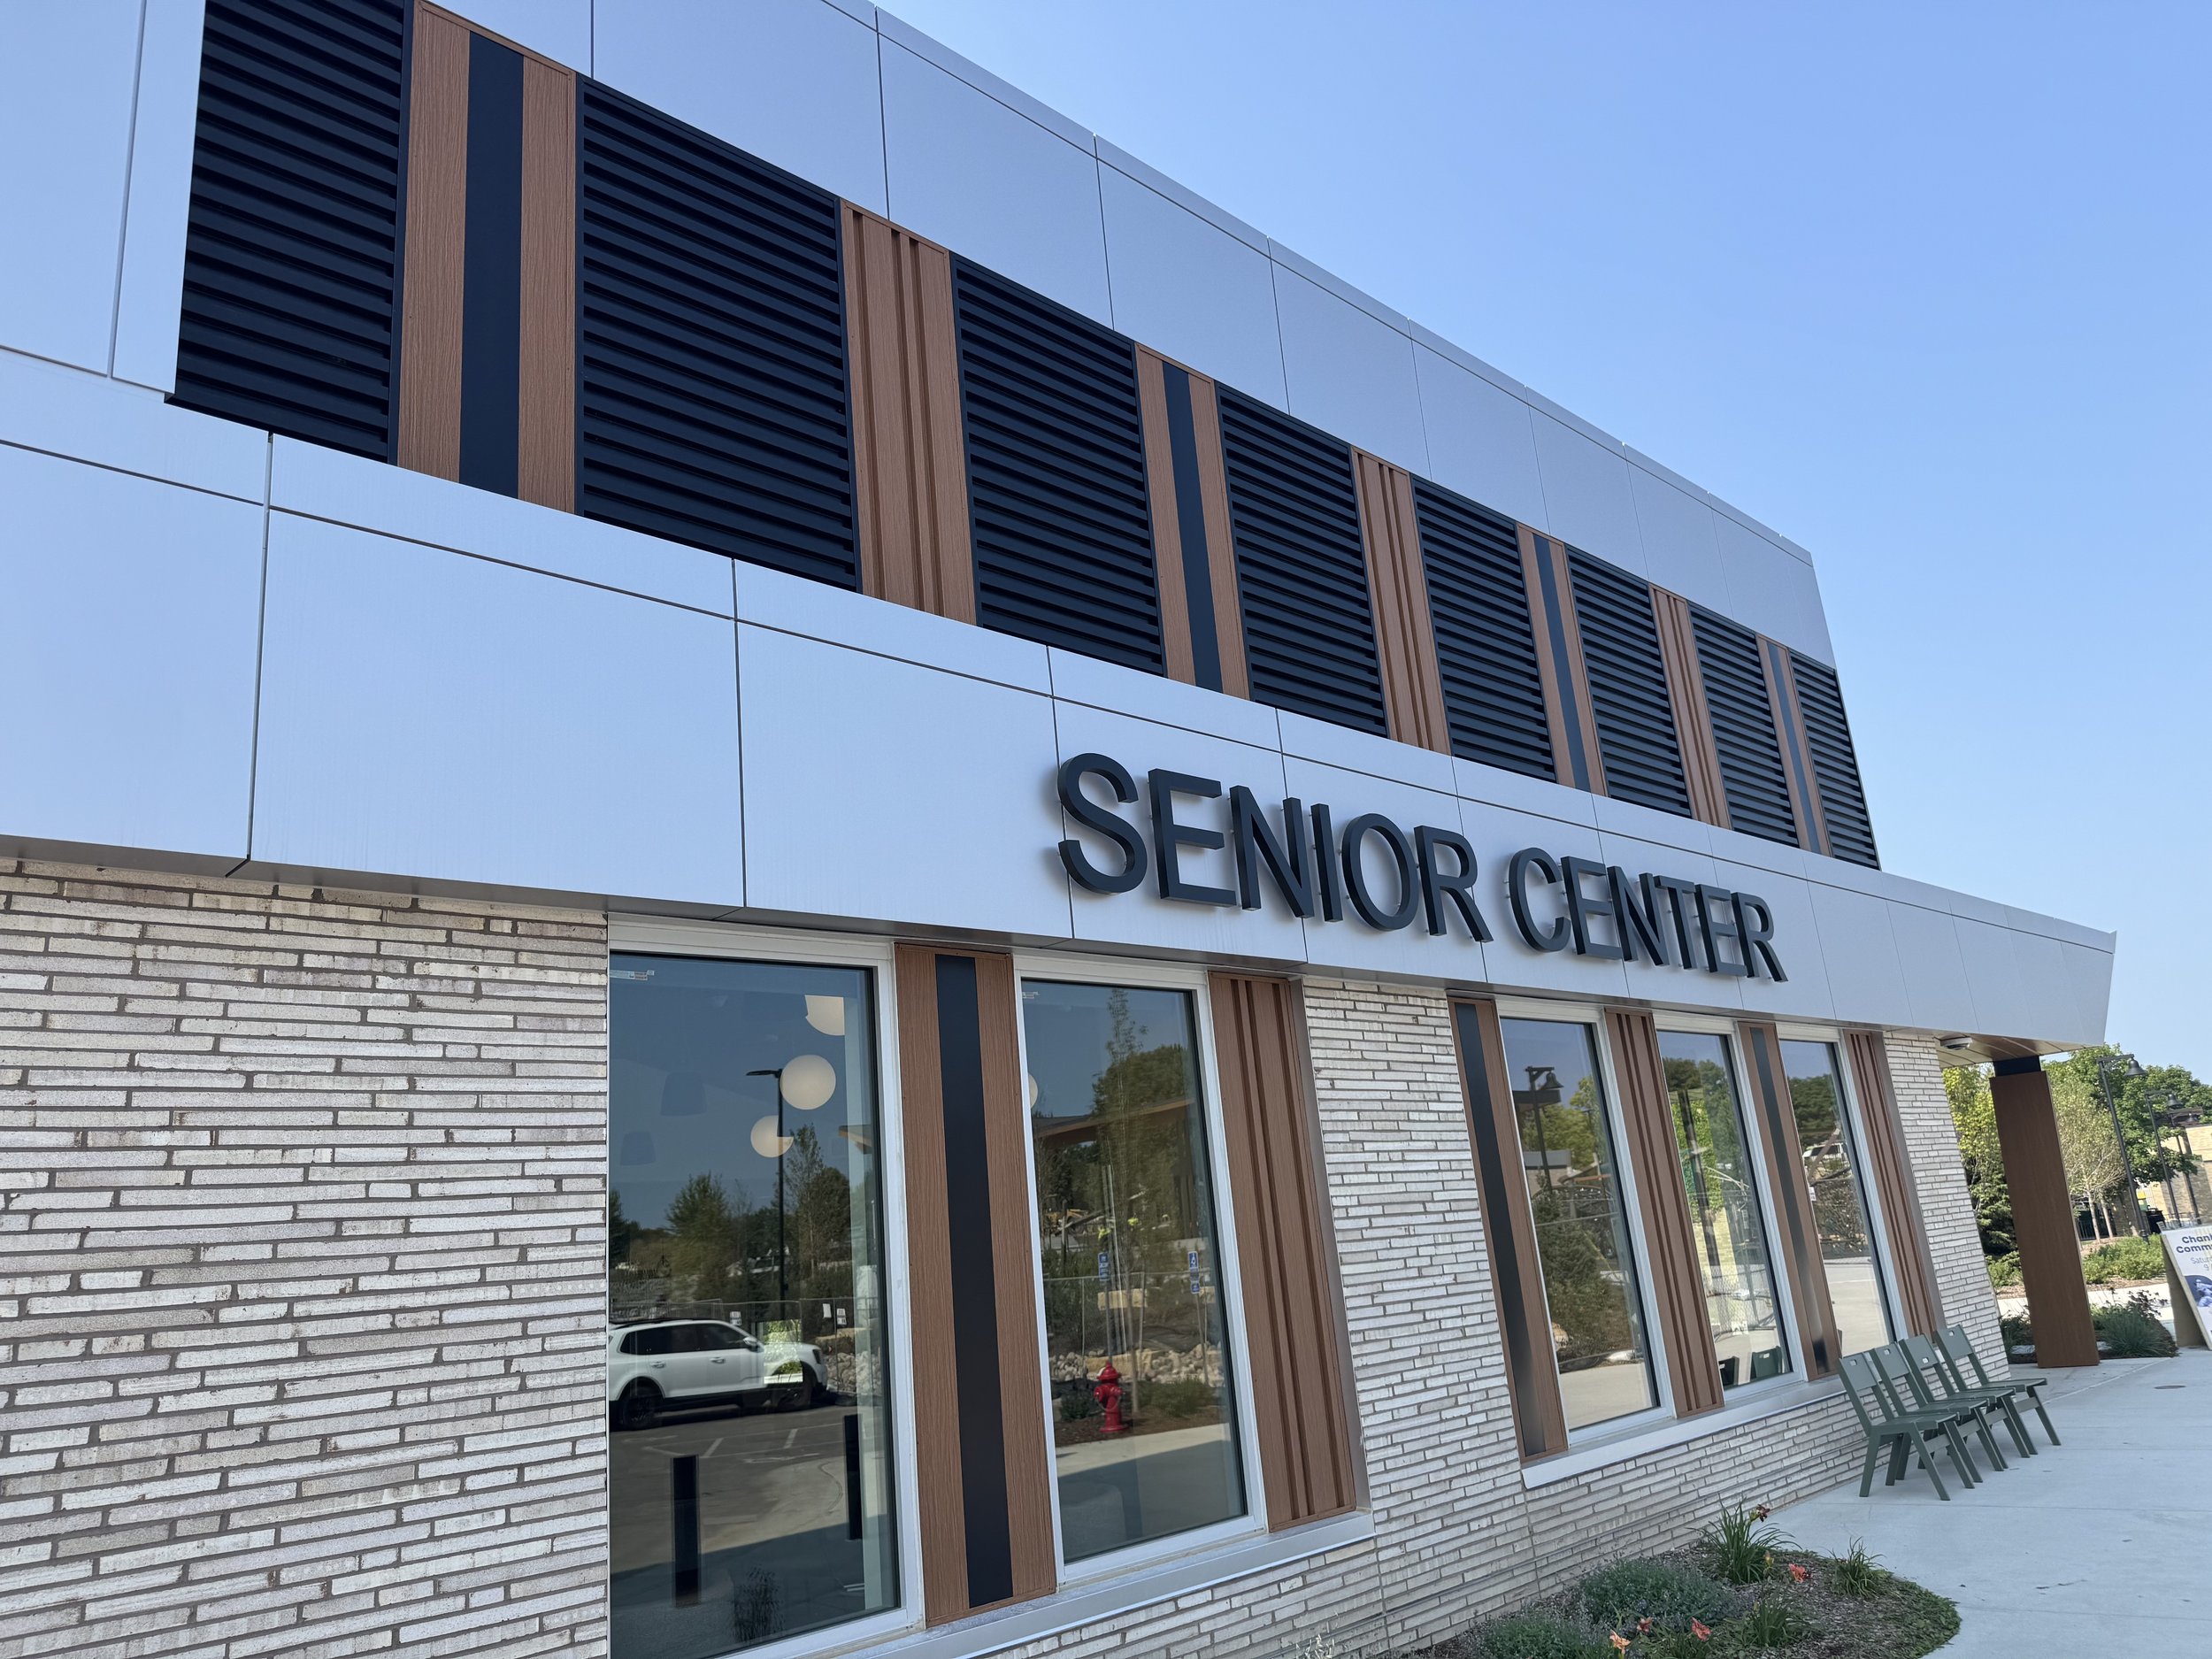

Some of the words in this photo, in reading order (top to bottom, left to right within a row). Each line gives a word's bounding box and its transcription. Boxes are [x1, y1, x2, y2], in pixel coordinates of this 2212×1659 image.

[1057, 752, 1494, 944] SENIOR
[1509, 847, 1788, 983] CENTER
[2176, 1244, 2212, 1254] Comm
